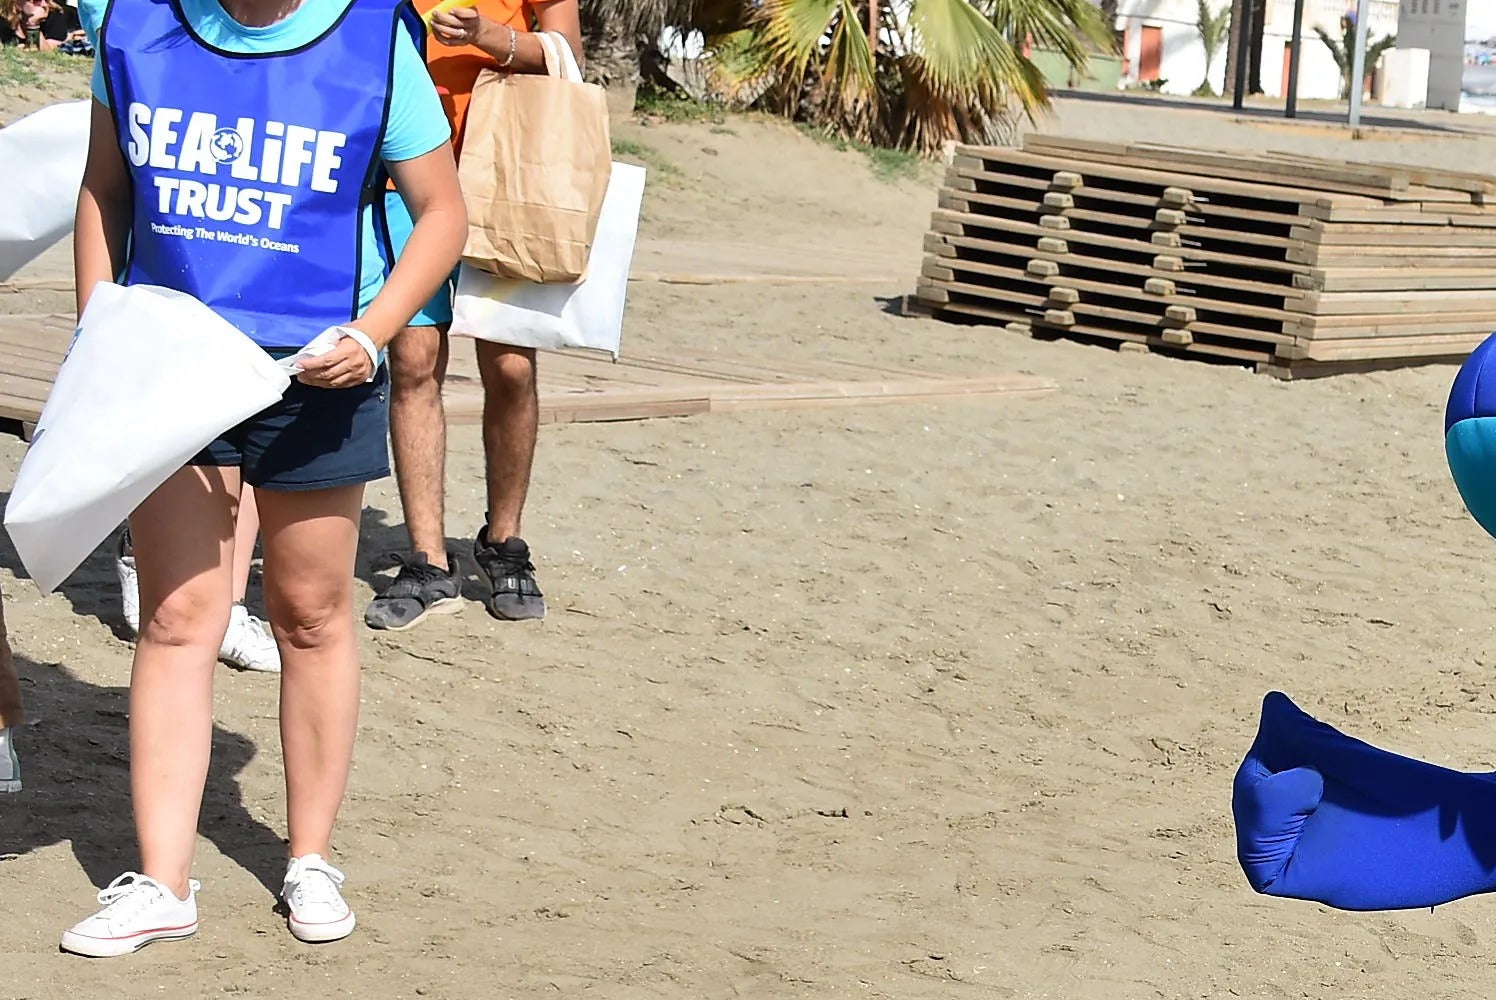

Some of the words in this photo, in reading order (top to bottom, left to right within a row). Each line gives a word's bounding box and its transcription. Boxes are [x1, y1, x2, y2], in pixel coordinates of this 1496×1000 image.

[128, 102, 217, 175] SEA
[153, 176, 292, 230] TRUST
[151, 222, 195, 240] Protecting
[195, 227, 215, 240] The
[216, 230, 259, 247] World's
[259, 237, 300, 254] Oceans
